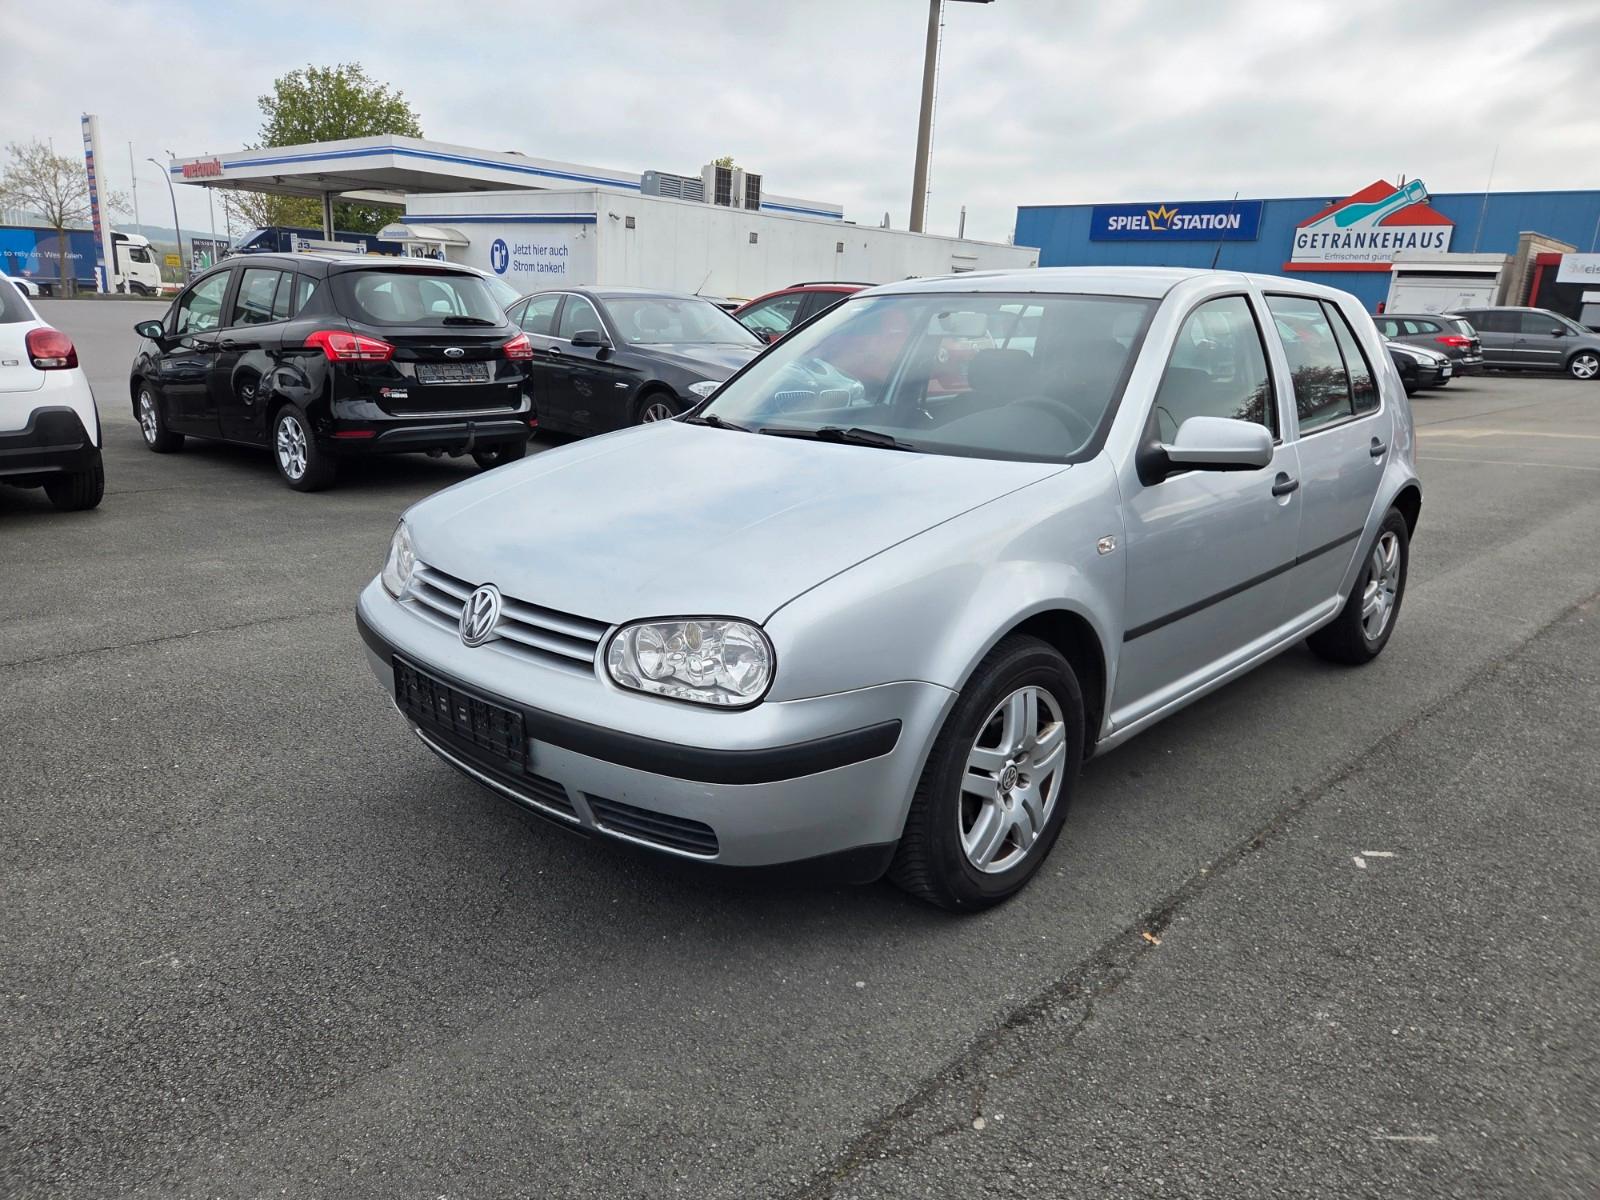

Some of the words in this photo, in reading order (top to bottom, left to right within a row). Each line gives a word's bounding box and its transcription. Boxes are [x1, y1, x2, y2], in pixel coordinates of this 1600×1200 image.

[1108, 215, 1150, 231] SPIEL
[1172, 213, 1241, 230] STATION
[1297, 228, 1445, 249] GETRÄNKEHAUS
[513, 243, 532, 255] Jetzt
[533, 244, 548, 256] hier
[549, 244, 569, 257] auch
[1324, 253, 1370, 261] Erfrischend
[513, 260, 536, 272] Strom
[537, 261, 565, 274] tanken!
